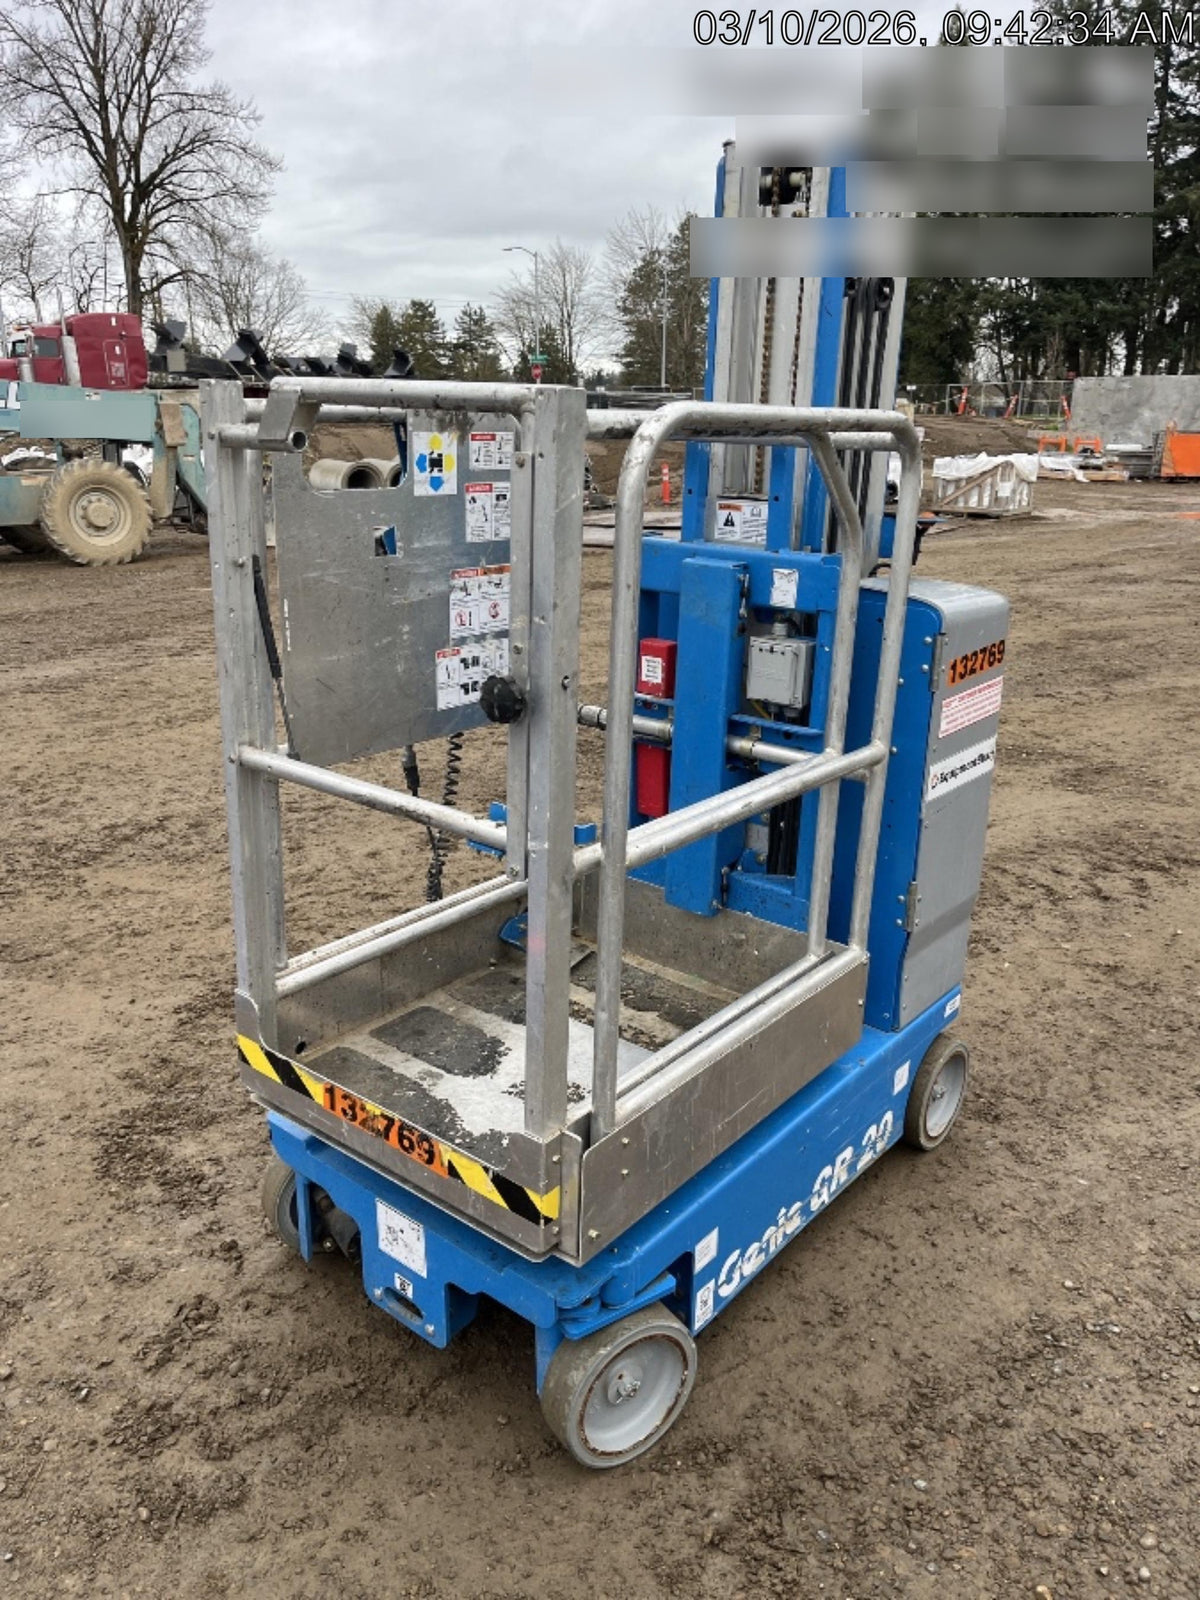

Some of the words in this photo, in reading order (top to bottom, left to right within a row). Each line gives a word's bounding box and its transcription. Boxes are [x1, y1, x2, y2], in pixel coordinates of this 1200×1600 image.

[950, 639, 1005, 684] 132769
[717, 1201, 803, 1297] Genie
[810, 1146, 854, 1212] GR
[857, 1110, 894, 1171] 20
